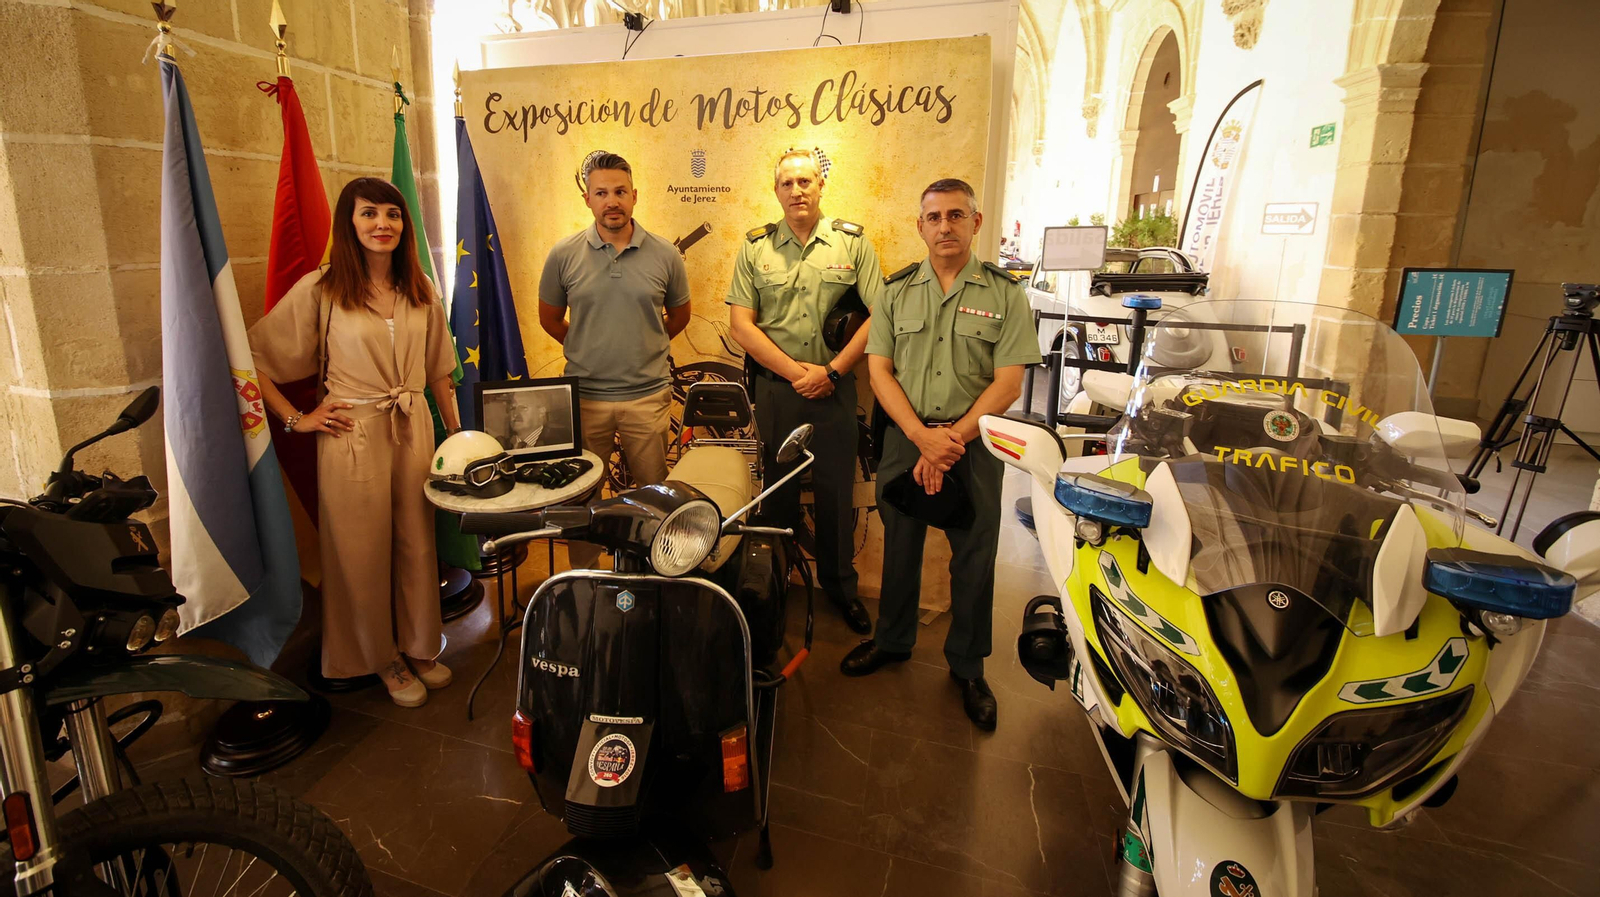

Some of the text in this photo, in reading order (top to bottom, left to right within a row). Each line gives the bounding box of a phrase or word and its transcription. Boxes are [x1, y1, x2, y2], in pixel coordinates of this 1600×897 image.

[483, 69, 957, 143] Exposición de Motos Clásicas
[666, 184, 731, 195] Ayuntamiento
[680, 194, 716, 204] de Jerez
[1264, 214, 1307, 224] SALIDA
[1407, 294, 1423, 329] Precios
[1429, 314, 1437, 329] Ticket
[1087, 334, 1118, 342] 60.346
[1182, 378, 1308, 407] GUARDIA
[1320, 390, 1381, 431] CIVIL
[531, 656, 581, 678] vespa
[591, 716, 642, 724] MOTOVESPA
